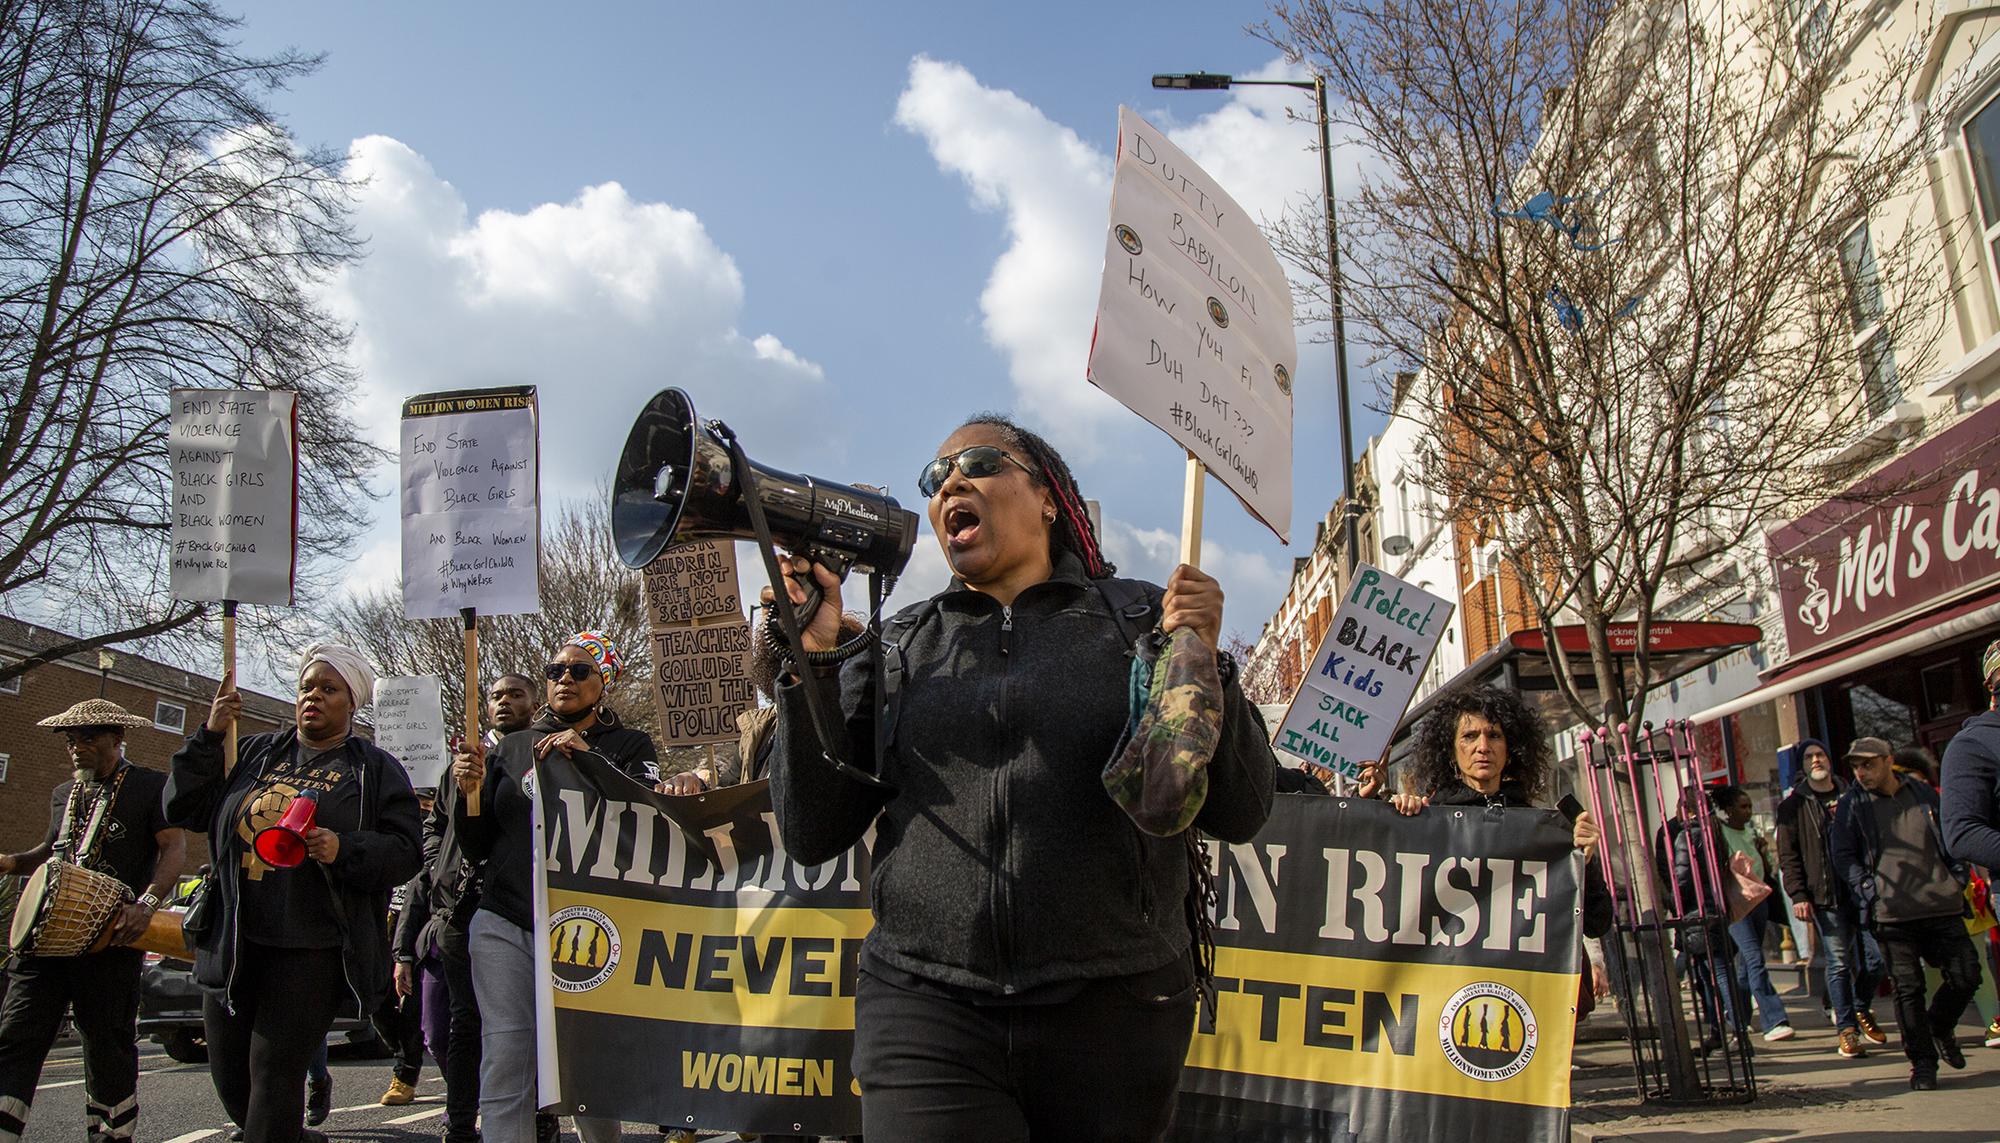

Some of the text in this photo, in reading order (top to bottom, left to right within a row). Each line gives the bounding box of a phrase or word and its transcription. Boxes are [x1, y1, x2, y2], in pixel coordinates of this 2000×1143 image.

[1169, 212, 1258, 316] BABYLON
[1196, 321, 1224, 362] YUH
[1145, 338, 1184, 384] DUH
[183, 401, 256, 415] END STATE
[409, 401, 454, 415] MILLION
[180, 424, 242, 437] VIOLENCE
[413, 432, 479, 455] END STATE
[179, 449, 234, 464] AGAINST
[179, 471, 264, 487] BLACK GIRLS
[180, 493, 206, 506] AND
[443, 486, 516, 512] BLACK GIRLS
[179, 513, 265, 527] BLACK WOMEN
[429, 530, 527, 546] AND BLACK WOMEN
[1832, 502, 1931, 616] Mel's
[648, 567, 729, 593] ARE NOT
[652, 585, 716, 608] SAFE IN
[660, 595, 736, 622] SCHOOLS
[1350, 569, 1436, 636] Protect
[655, 625, 750, 657] TEACHERS
[1336, 617, 1421, 675] BLACK
[660, 654, 744, 682] COLLUDE
[1321, 651, 1384, 697] Kids
[661, 678, 753, 708] WITH THE
[1318, 694, 1370, 729] SACK
[1307, 718, 1340, 743] ALL
[1318, 847, 1548, 954] RISE
[682, 1051, 834, 1097] WOMEN
